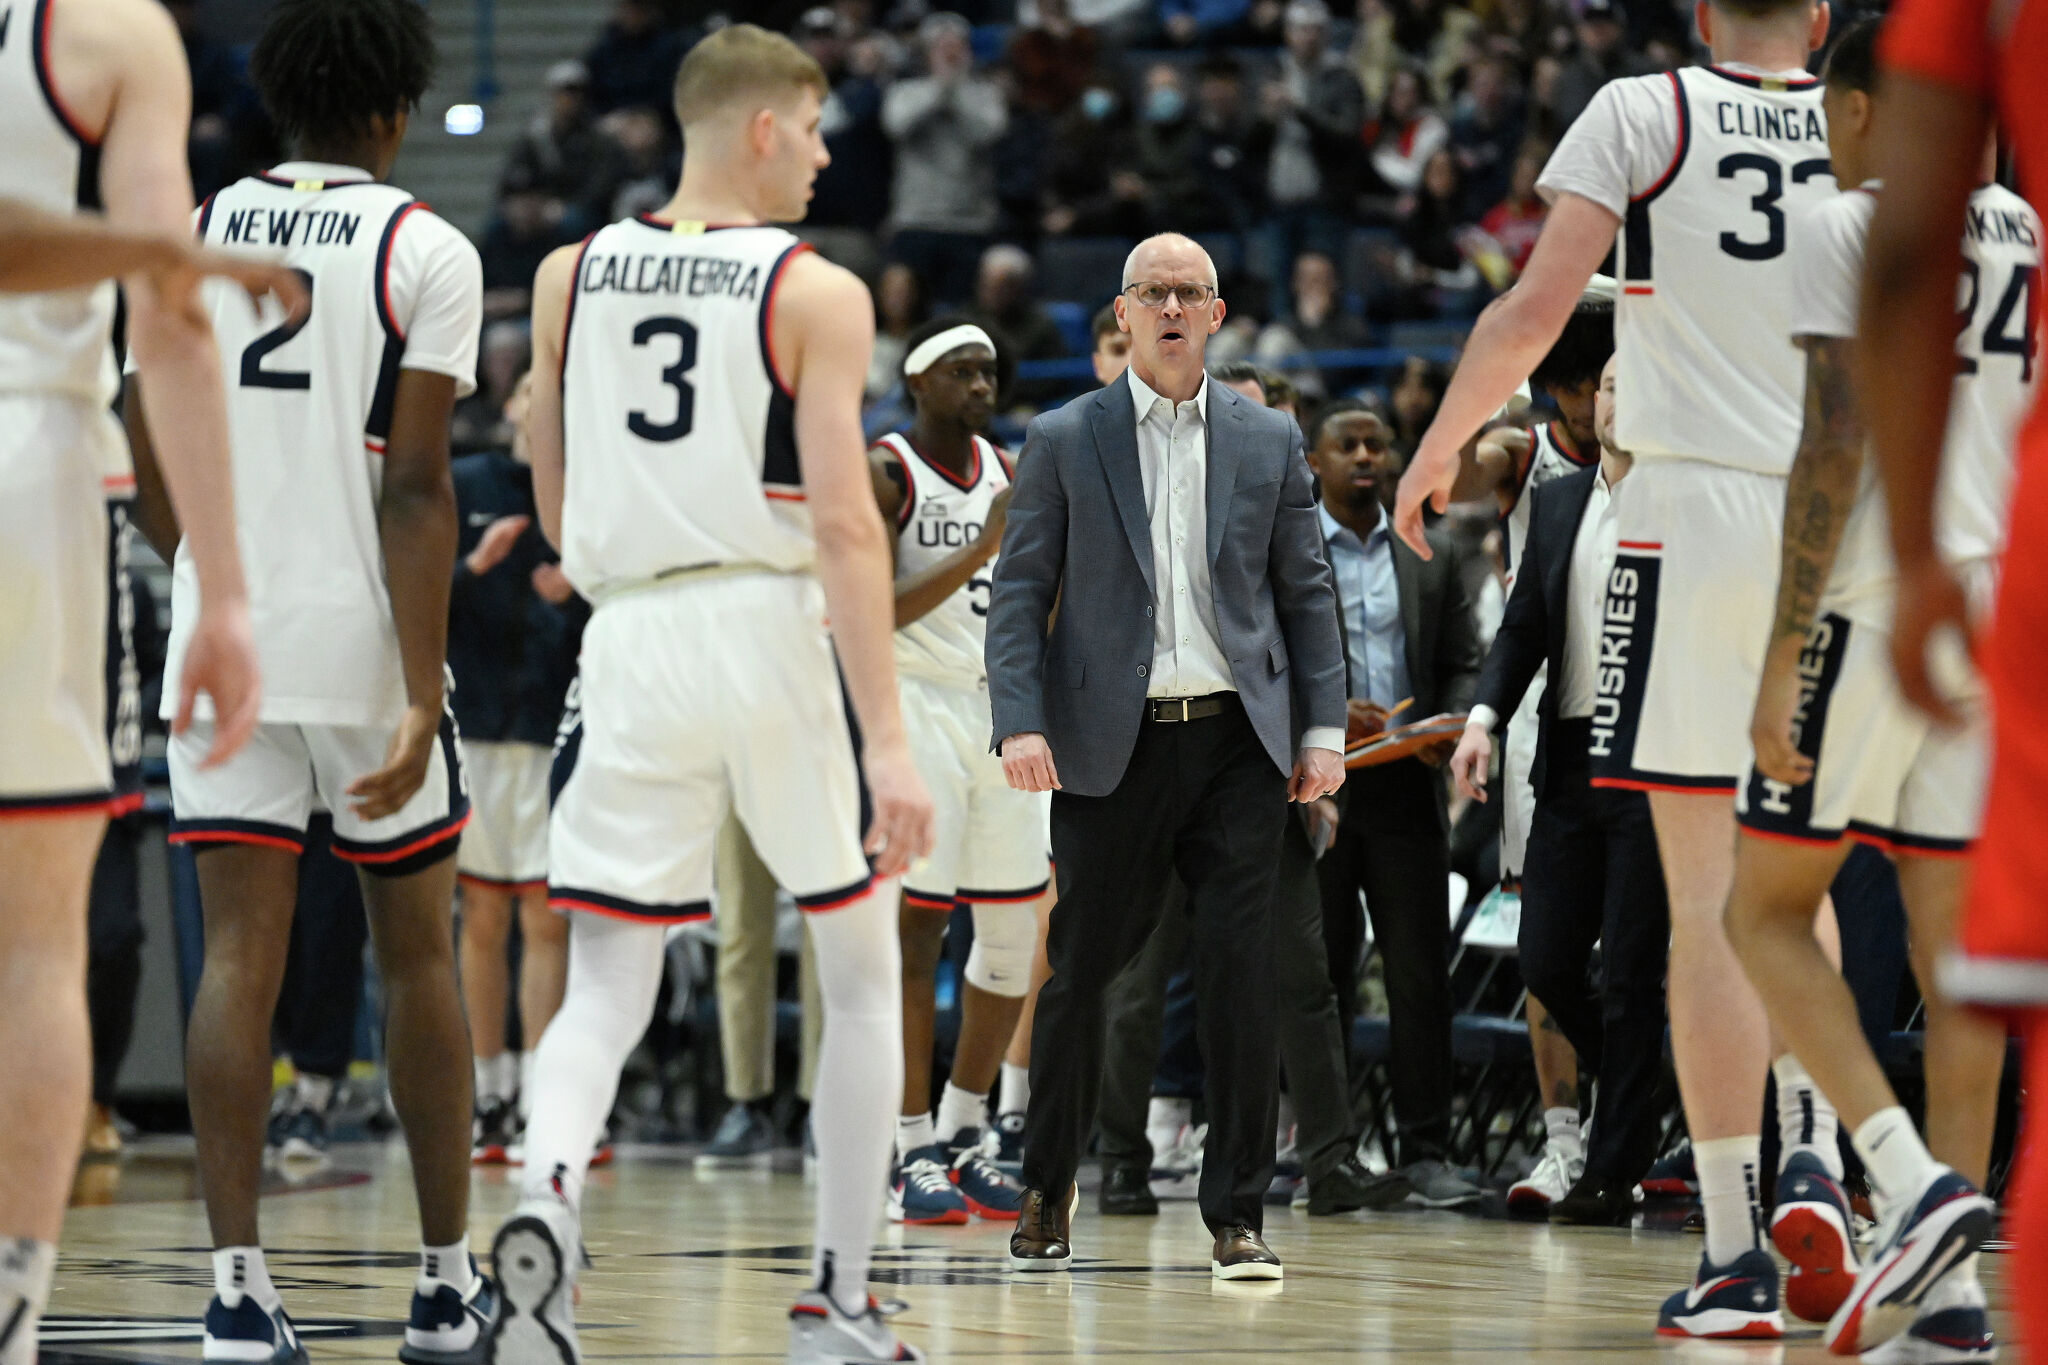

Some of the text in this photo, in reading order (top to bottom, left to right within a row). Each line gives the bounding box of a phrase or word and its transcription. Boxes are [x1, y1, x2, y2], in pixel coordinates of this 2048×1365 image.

[223, 208, 361, 246] NEWTON
[584, 255, 760, 301] CALCATERRA
[240, 266, 313, 390] 2
[628, 316, 698, 441] 3
[1588, 567, 1639, 756] HUSKIES
